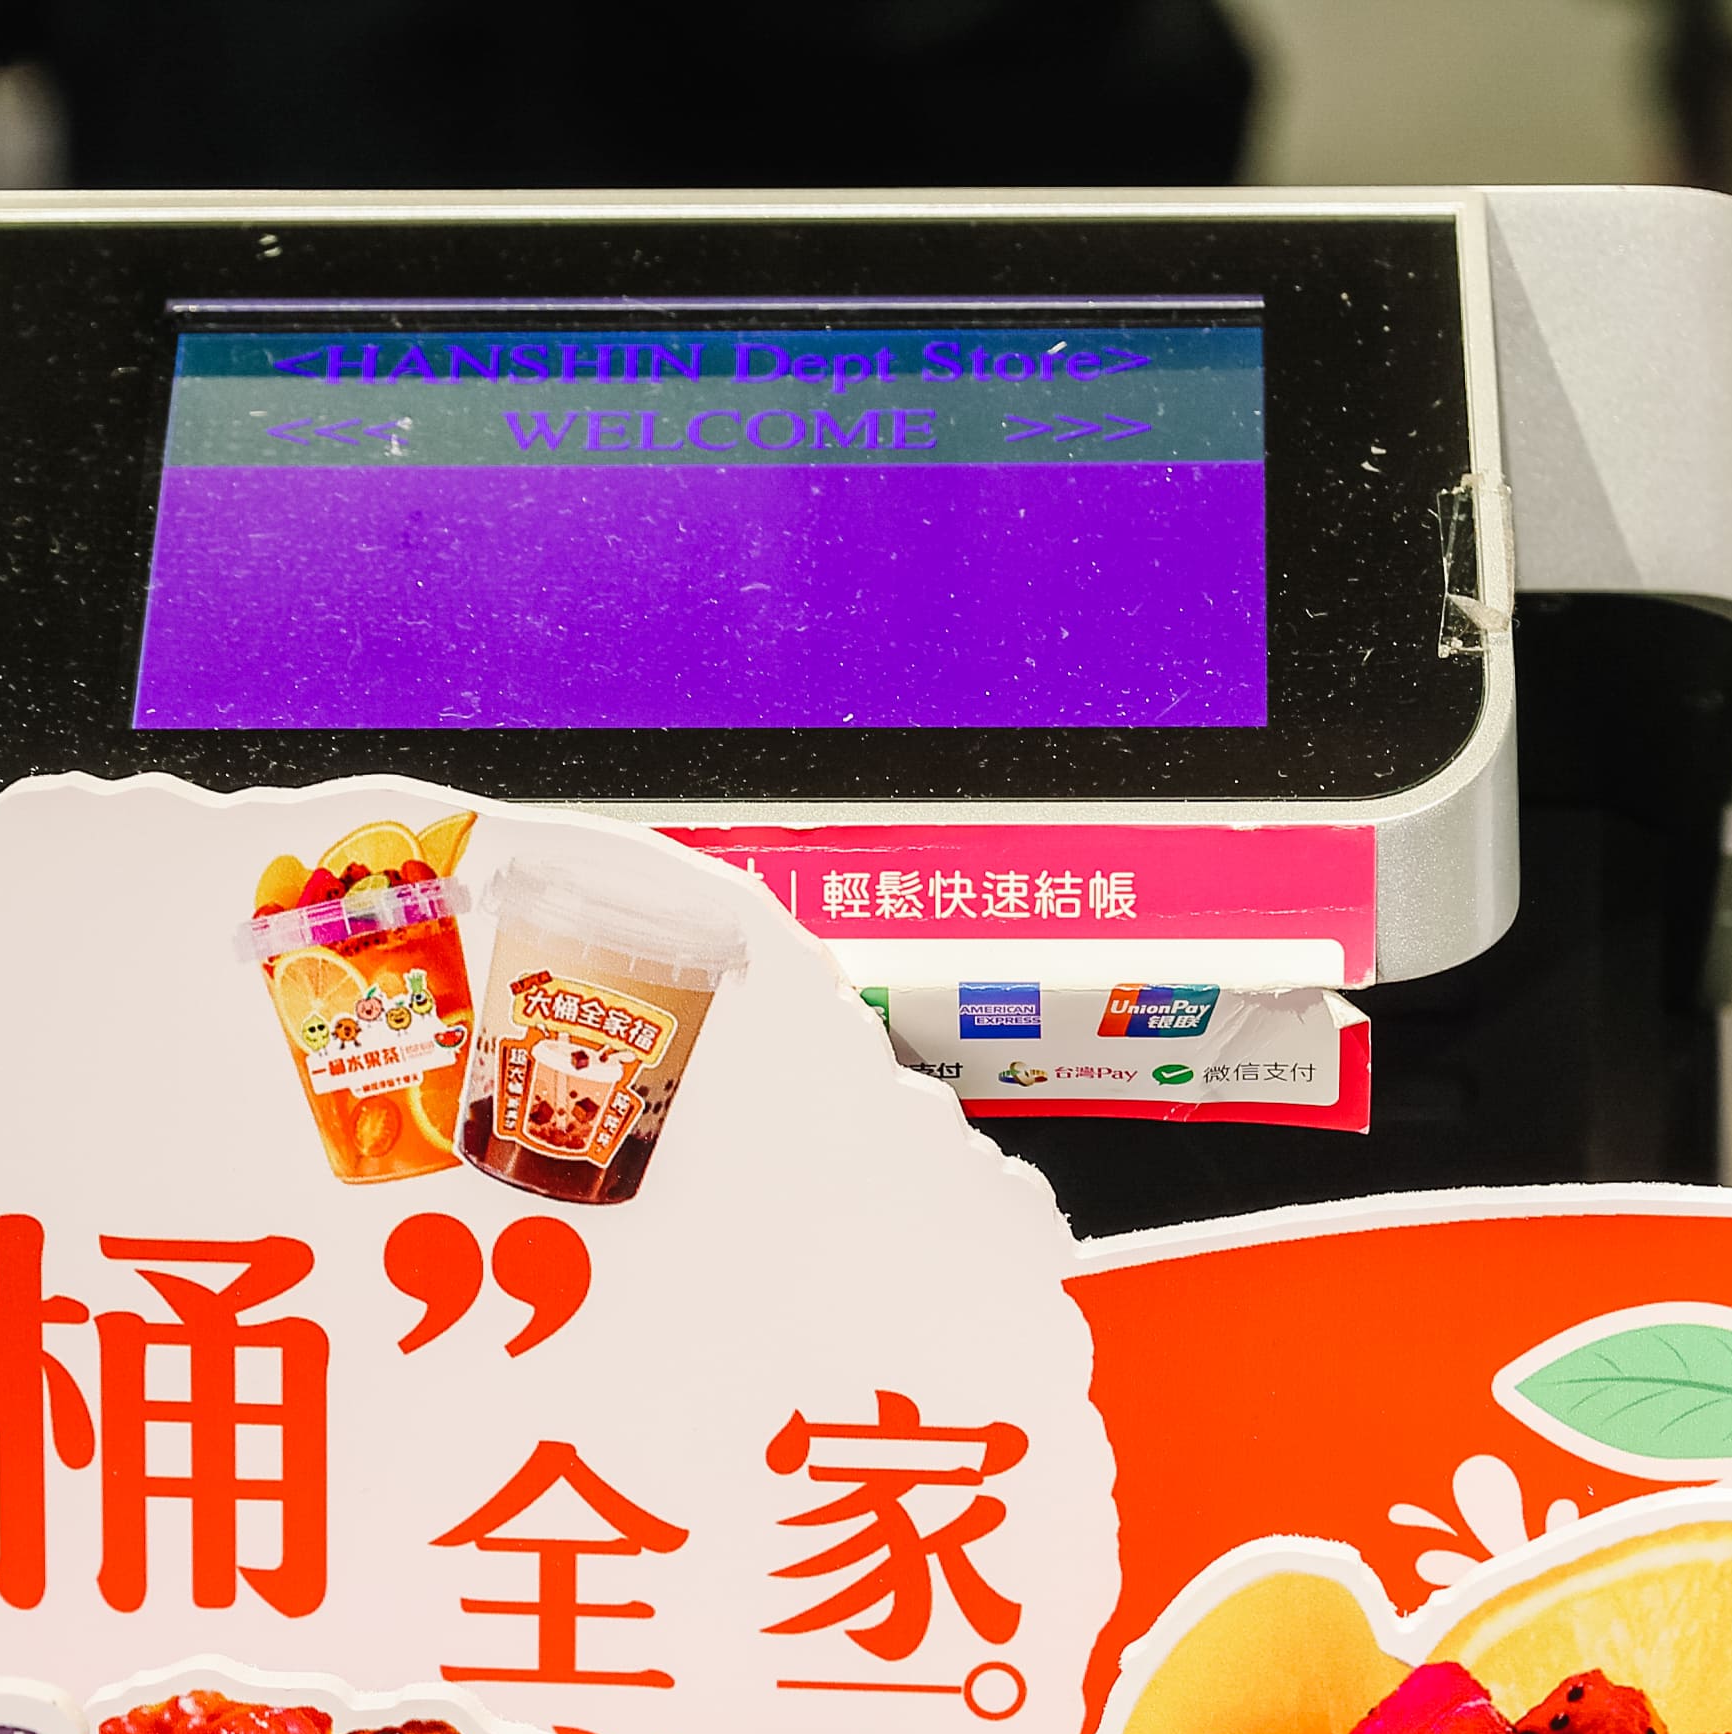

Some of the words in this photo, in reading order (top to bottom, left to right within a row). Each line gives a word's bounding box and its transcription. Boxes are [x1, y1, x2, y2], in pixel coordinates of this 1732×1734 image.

[735, 343, 894, 394] Dept
[504, 408, 940, 451] WELCOME
[822, 870, 1137, 921] 輕鬆快速結帳
[959, 1004, 1036, 1015] AMERICAN
[974, 1014, 1041, 1025] EXPRESS
[1111, 1000, 1210, 1019] UnionPay
[524, 989, 660, 1052] 大桶全家福
[1147, 1016, 1200, 1029] 银联
[1054, 1066, 1138, 1083] 台灣Pay
[1203, 1061, 1316, 1084] 微信支付
